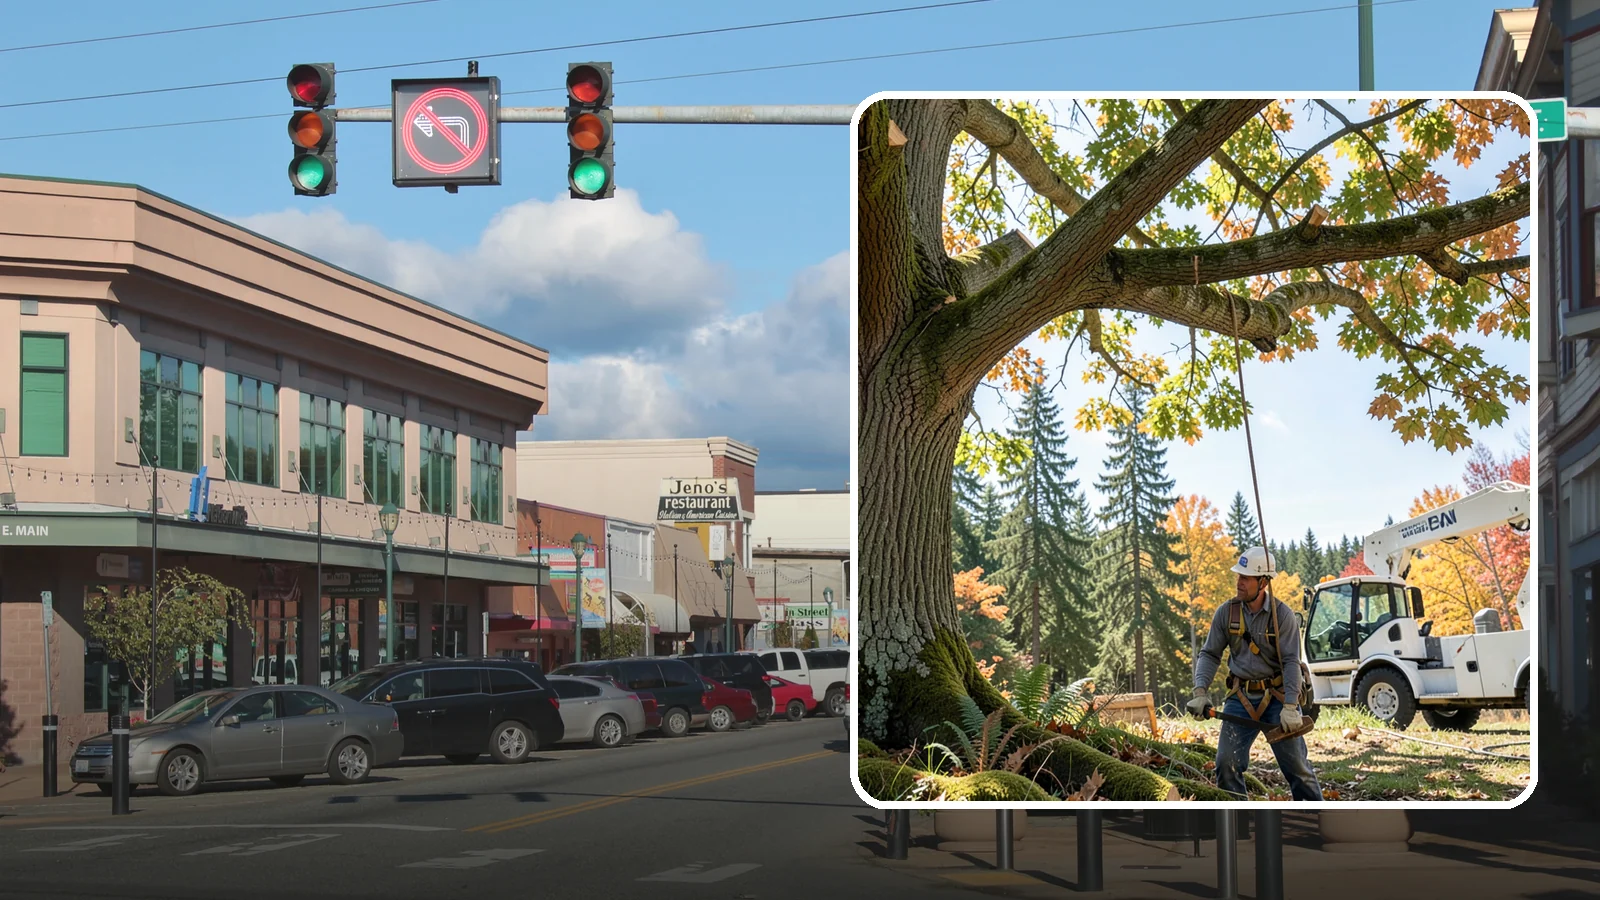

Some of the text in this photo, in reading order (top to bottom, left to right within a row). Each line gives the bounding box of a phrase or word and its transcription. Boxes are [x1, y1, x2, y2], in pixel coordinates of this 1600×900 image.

[670, 480, 727, 494] Jeno's
[665, 496, 731, 509] restaurant
[659, 510, 681, 519] Italian
[686, 510, 715, 519] American
[715, 509, 738, 519] Cuisine
[2, 525, 49, 536] E. MAIN
[797, 607, 828, 616] Street
